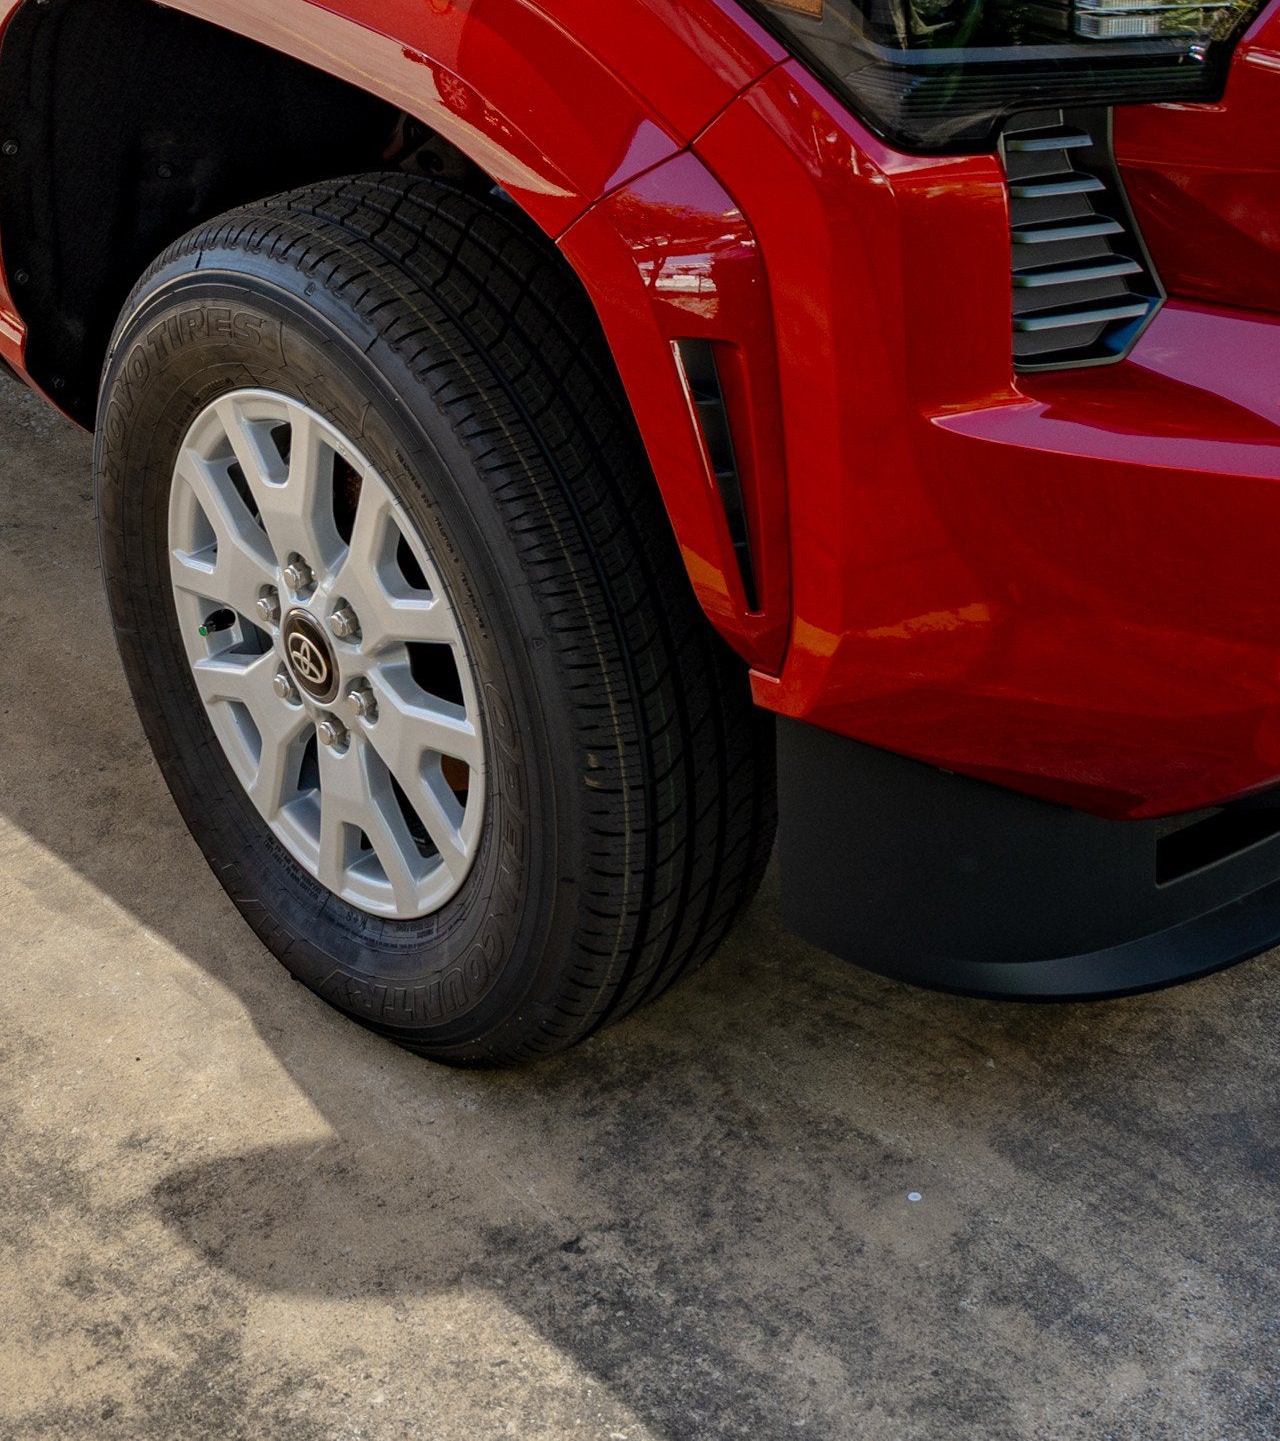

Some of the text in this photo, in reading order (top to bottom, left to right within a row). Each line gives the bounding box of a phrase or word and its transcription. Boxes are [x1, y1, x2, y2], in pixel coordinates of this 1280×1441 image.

[101, 345, 151, 485] TOYO
[147, 307, 266, 366] TIRES
[320, 912, 508, 1021] COUNTRY
